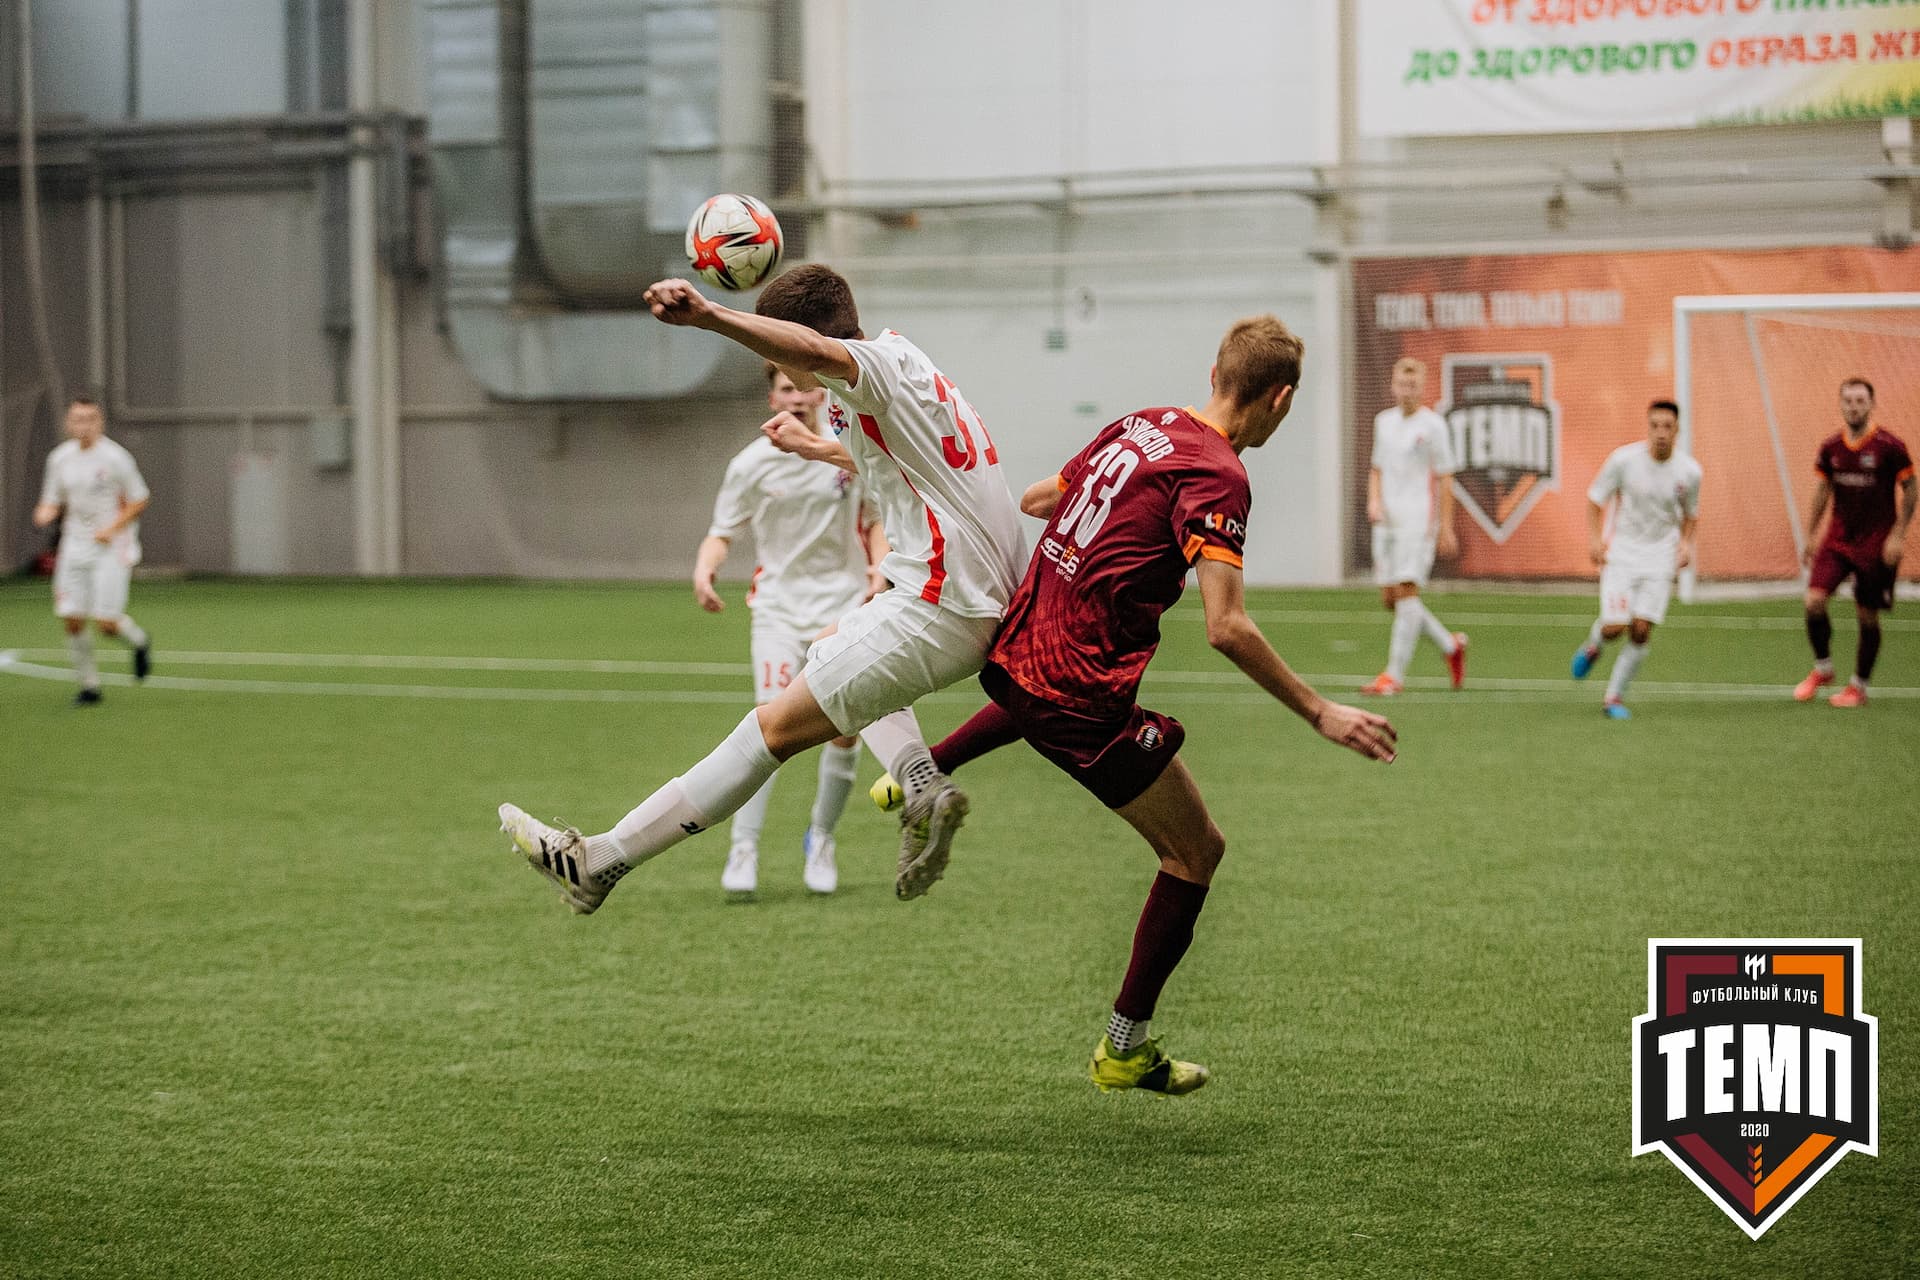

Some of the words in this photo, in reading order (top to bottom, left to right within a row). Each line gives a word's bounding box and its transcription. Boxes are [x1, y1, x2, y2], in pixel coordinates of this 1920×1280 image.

[1404, 47, 1459, 83] ДО
[1468, 39, 1696, 80] ЗДОРОВОГО
[1707, 32, 1857, 69] ОБРАЗА
[1056, 441, 1140, 549] 33
[763, 660, 793, 688] 15
